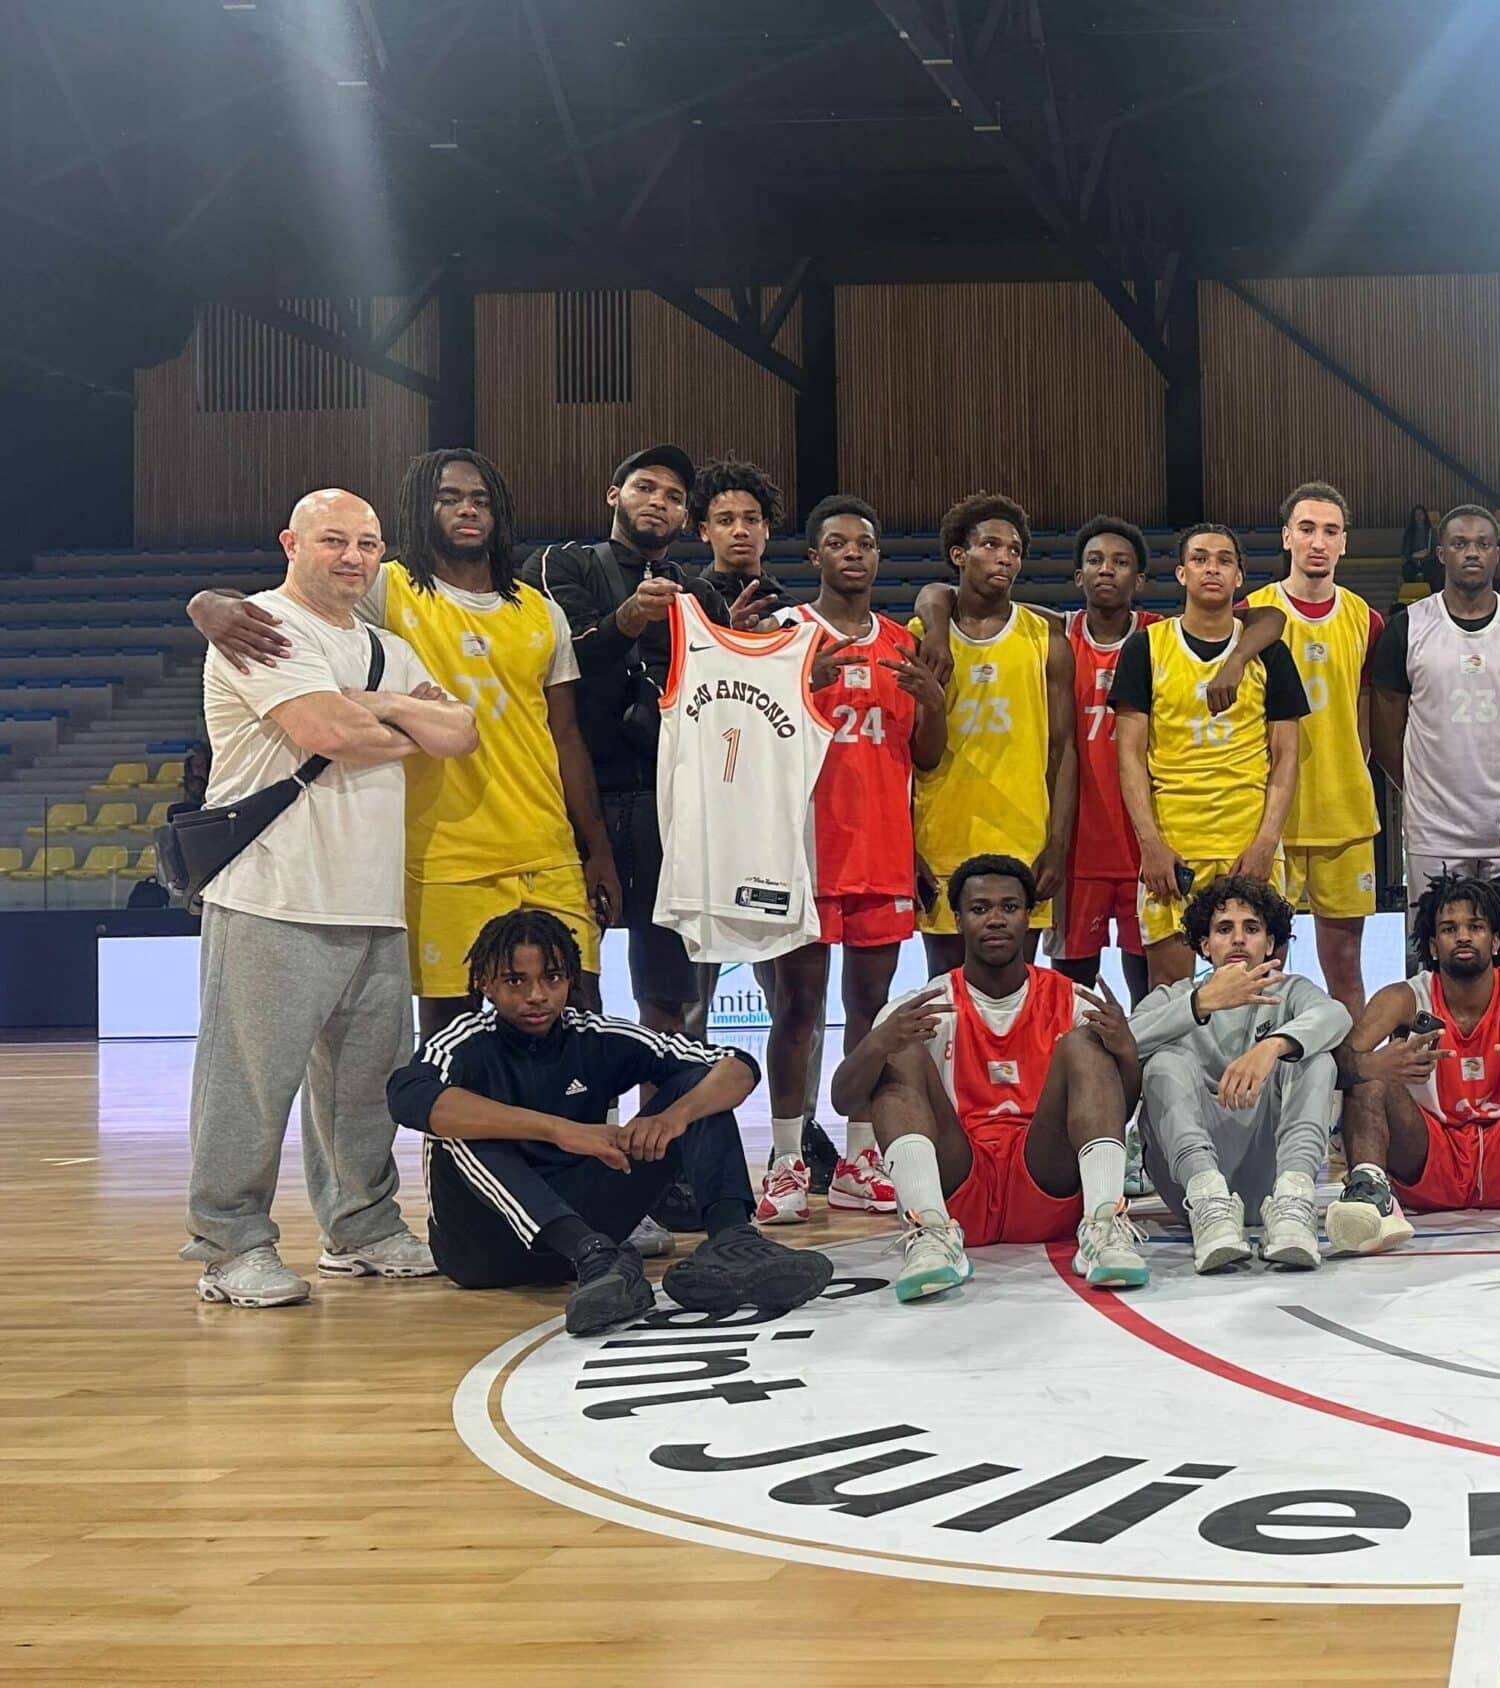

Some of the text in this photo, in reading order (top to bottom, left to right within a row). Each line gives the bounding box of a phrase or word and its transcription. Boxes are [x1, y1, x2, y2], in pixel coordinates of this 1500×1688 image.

[715, 680, 796, 739] ANTONIO
[832, 703, 886, 745] 24
[958, 697, 1013, 735] 23
[1449, 688, 1498, 723] 23
[1185, 716, 1233, 747] 10
[721, 727, 741, 784] 1
